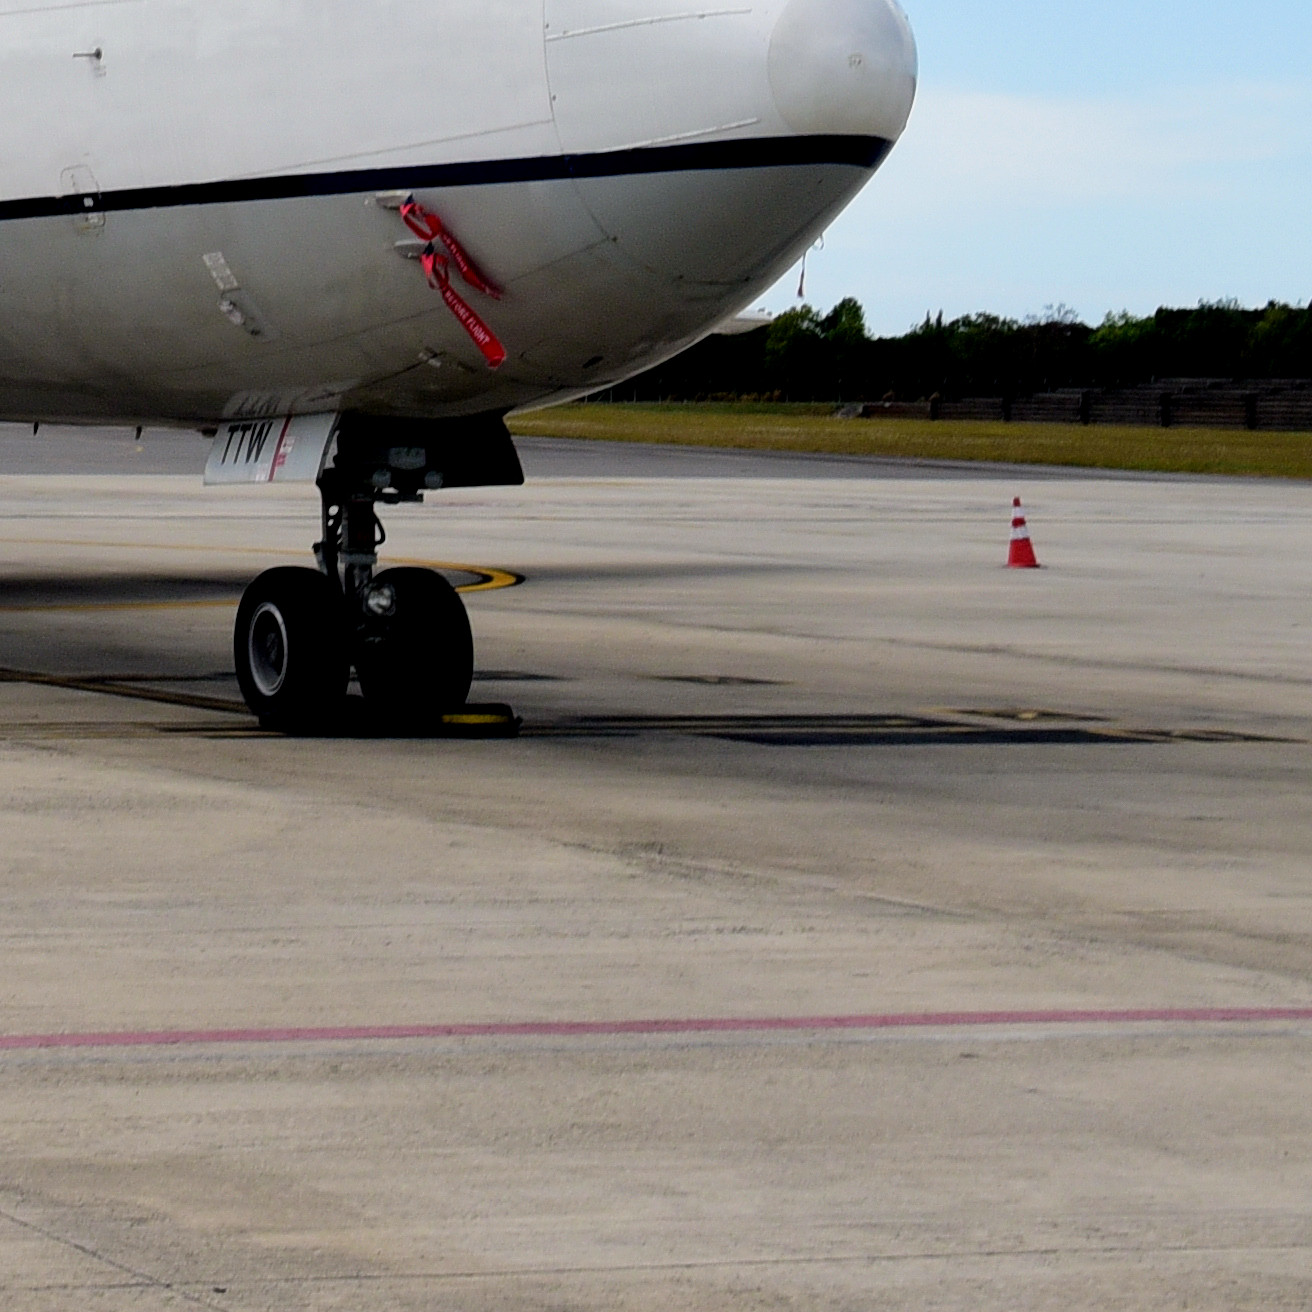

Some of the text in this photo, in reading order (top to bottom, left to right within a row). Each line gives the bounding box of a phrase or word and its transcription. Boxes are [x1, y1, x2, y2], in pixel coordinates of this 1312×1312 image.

[444, 289, 491, 345] BEFORE FLIGHT
[221, 421, 274, 465] TTW
